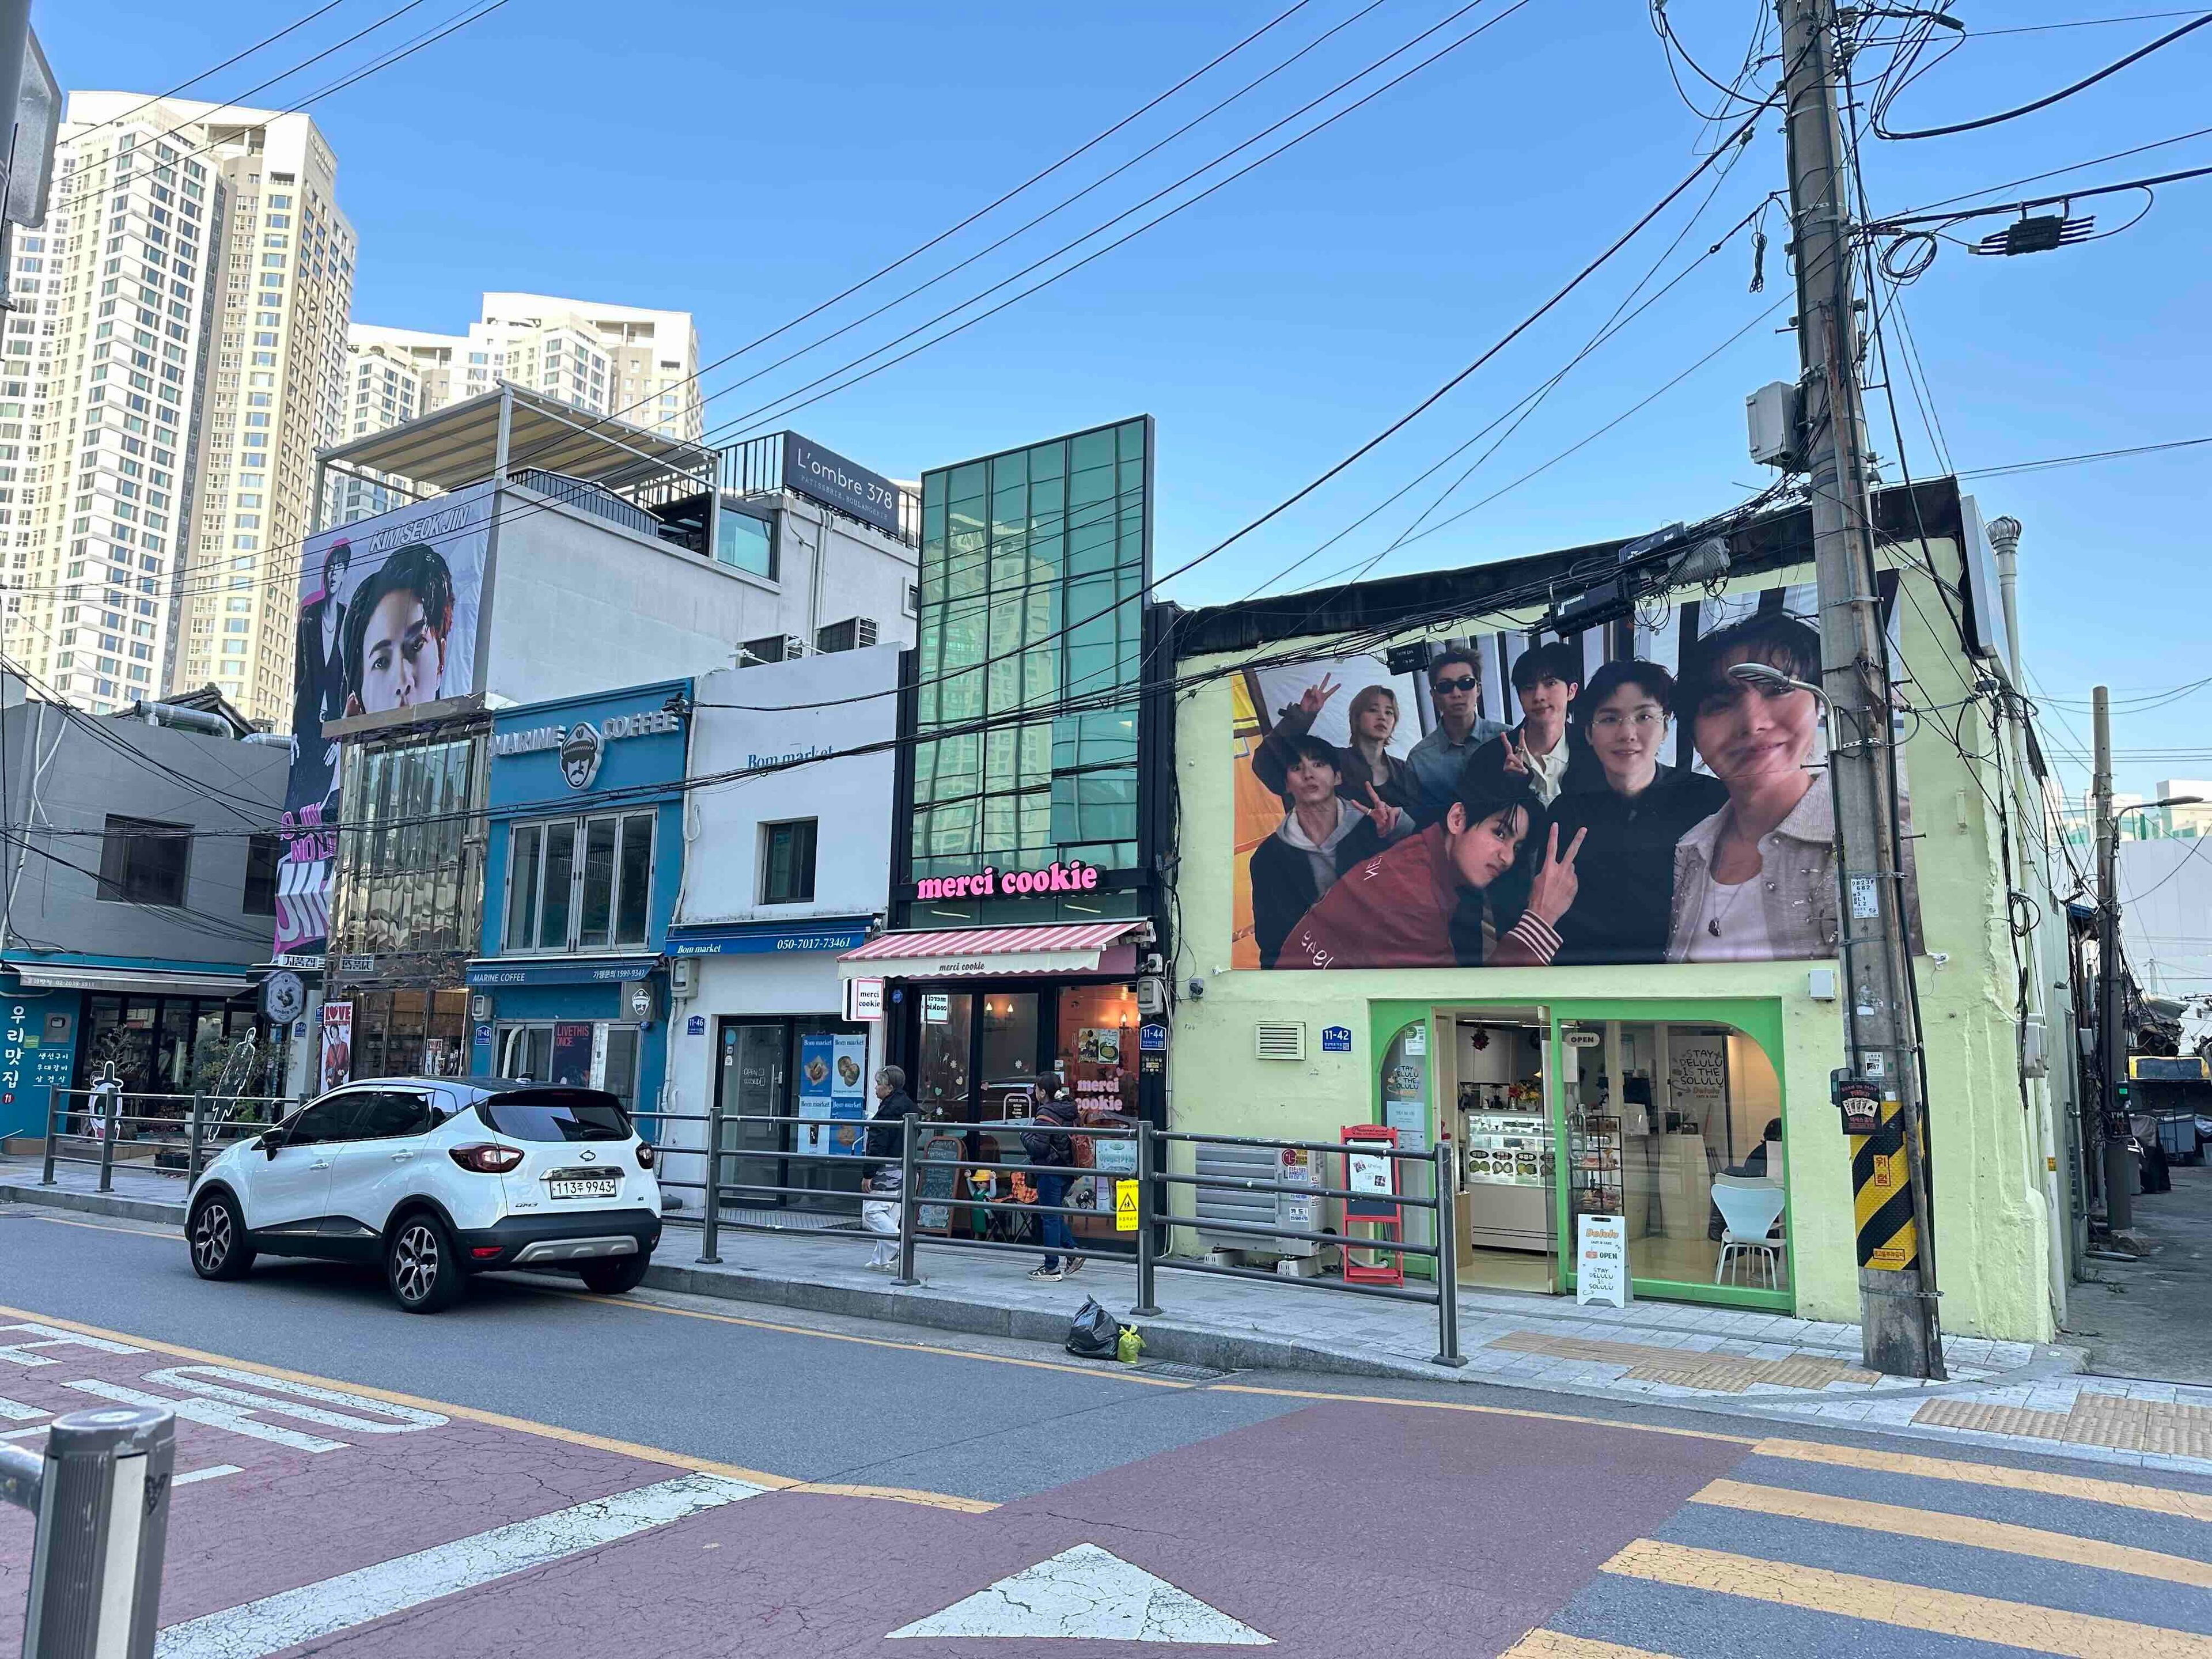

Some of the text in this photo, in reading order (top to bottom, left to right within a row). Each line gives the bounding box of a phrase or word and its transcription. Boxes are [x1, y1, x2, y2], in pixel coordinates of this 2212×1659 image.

[797, 448, 892, 510] L'ombre 378
[369, 506, 469, 552] KIM SEOK JIN
[490, 710, 679, 757] MARINE COFFEE
[748, 753, 778, 768] Bom
[917, 861, 1097, 899] merci cookie
[677, 944, 721, 953] Bom market
[777, 937, 851, 949] 050-7017-73461
[939, 961, 985, 971] merci cookie
[472, 973, 525, 982] MARINE COFFEE
[1143, 1029, 1164, 1039] 11-44
[1325, 1030, 1349, 1040] 11-42
[2, 1006, 26, 1088] 우리맛집
[1687, 1050, 1714, 1058] STAY
[1680, 1058, 1722, 1067] DELULU
[1697, 1068, 1719, 1076] THE
[1077, 1077, 1119, 1093] merci
[1680, 1076, 1724, 1085] SOLULU
[1876, 1157, 1888, 1184] 위험
[556, 1181, 611, 1194] 113주 9943
[1600, 1252, 1618, 1260] OPEN
